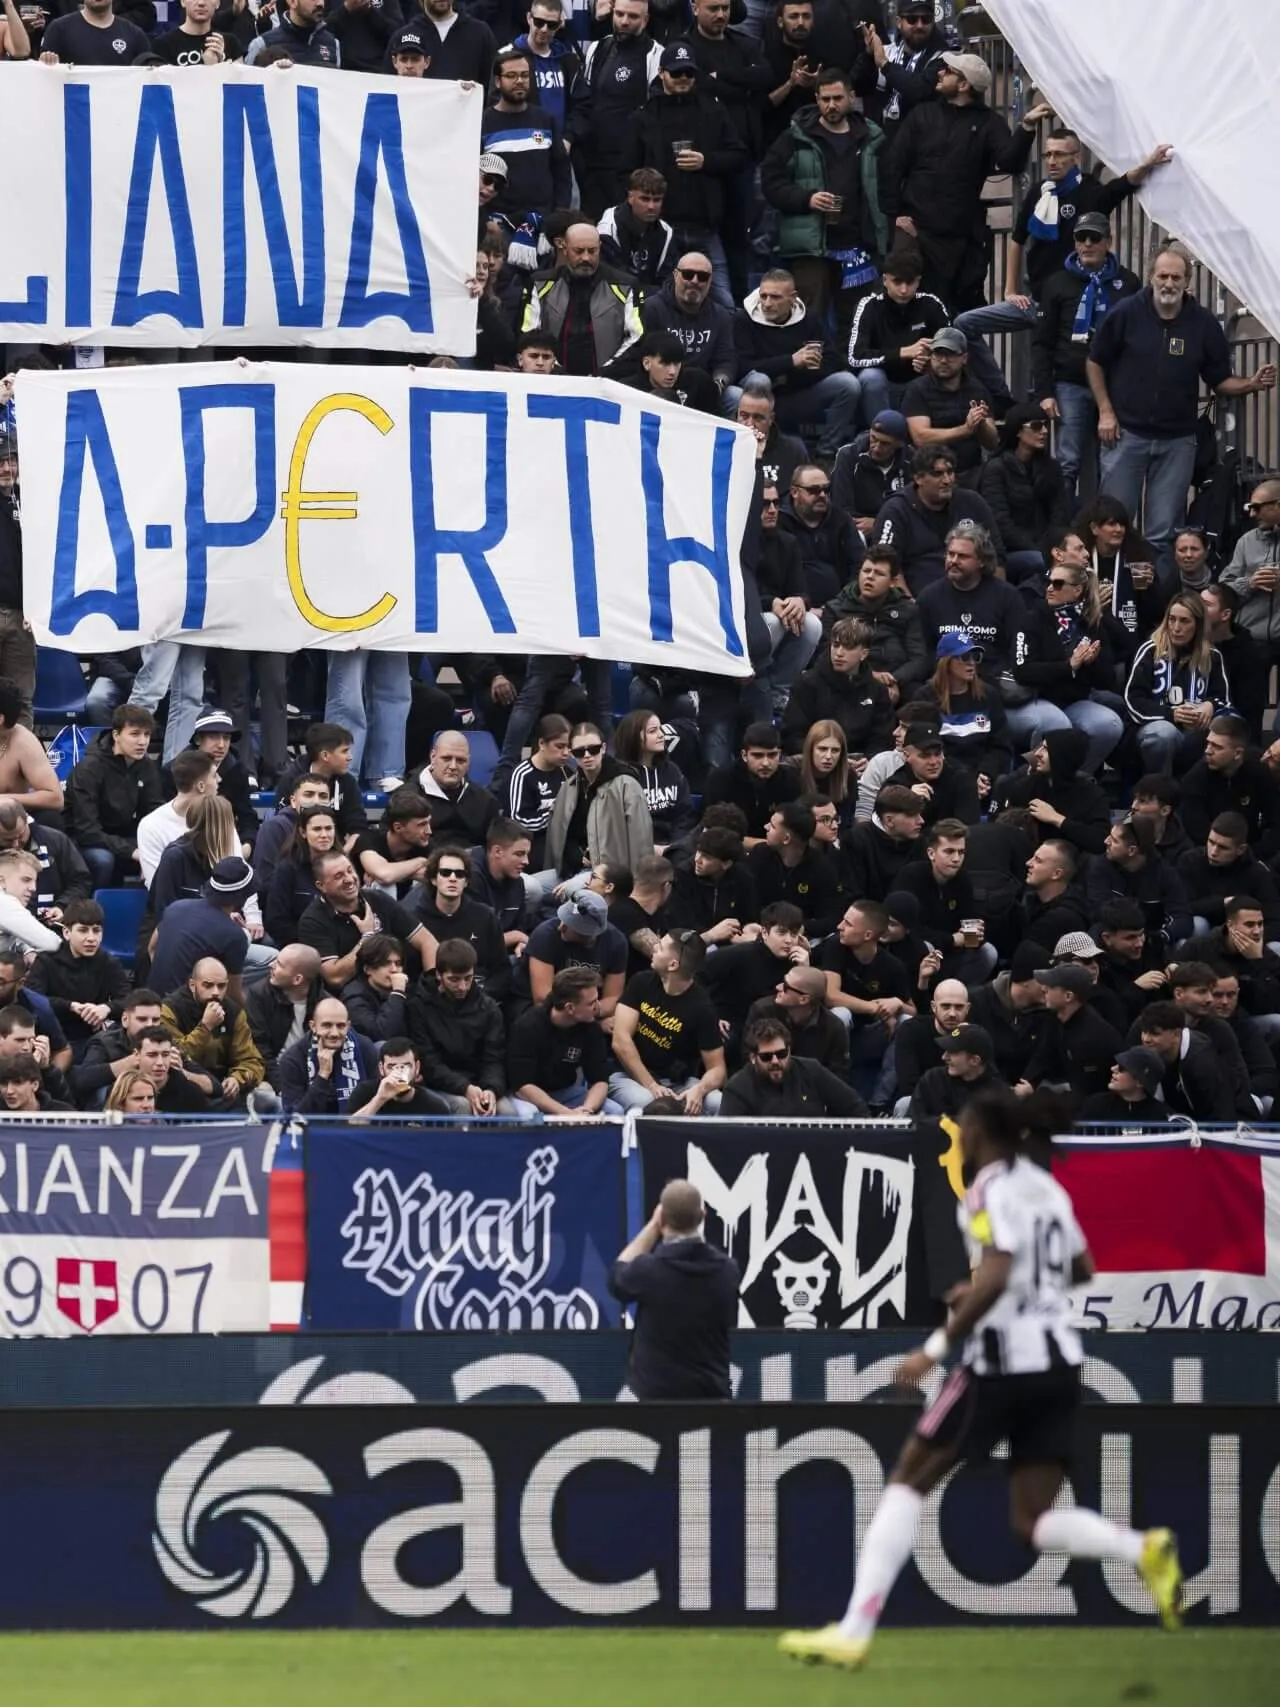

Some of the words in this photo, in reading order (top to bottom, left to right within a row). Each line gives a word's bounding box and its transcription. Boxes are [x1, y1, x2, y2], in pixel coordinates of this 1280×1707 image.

[177, 50, 203, 66] CO
[967, 626, 997, 635] COMO
[687, 1141, 917, 1311] MAD
[131, 1262, 214, 1334] 07
